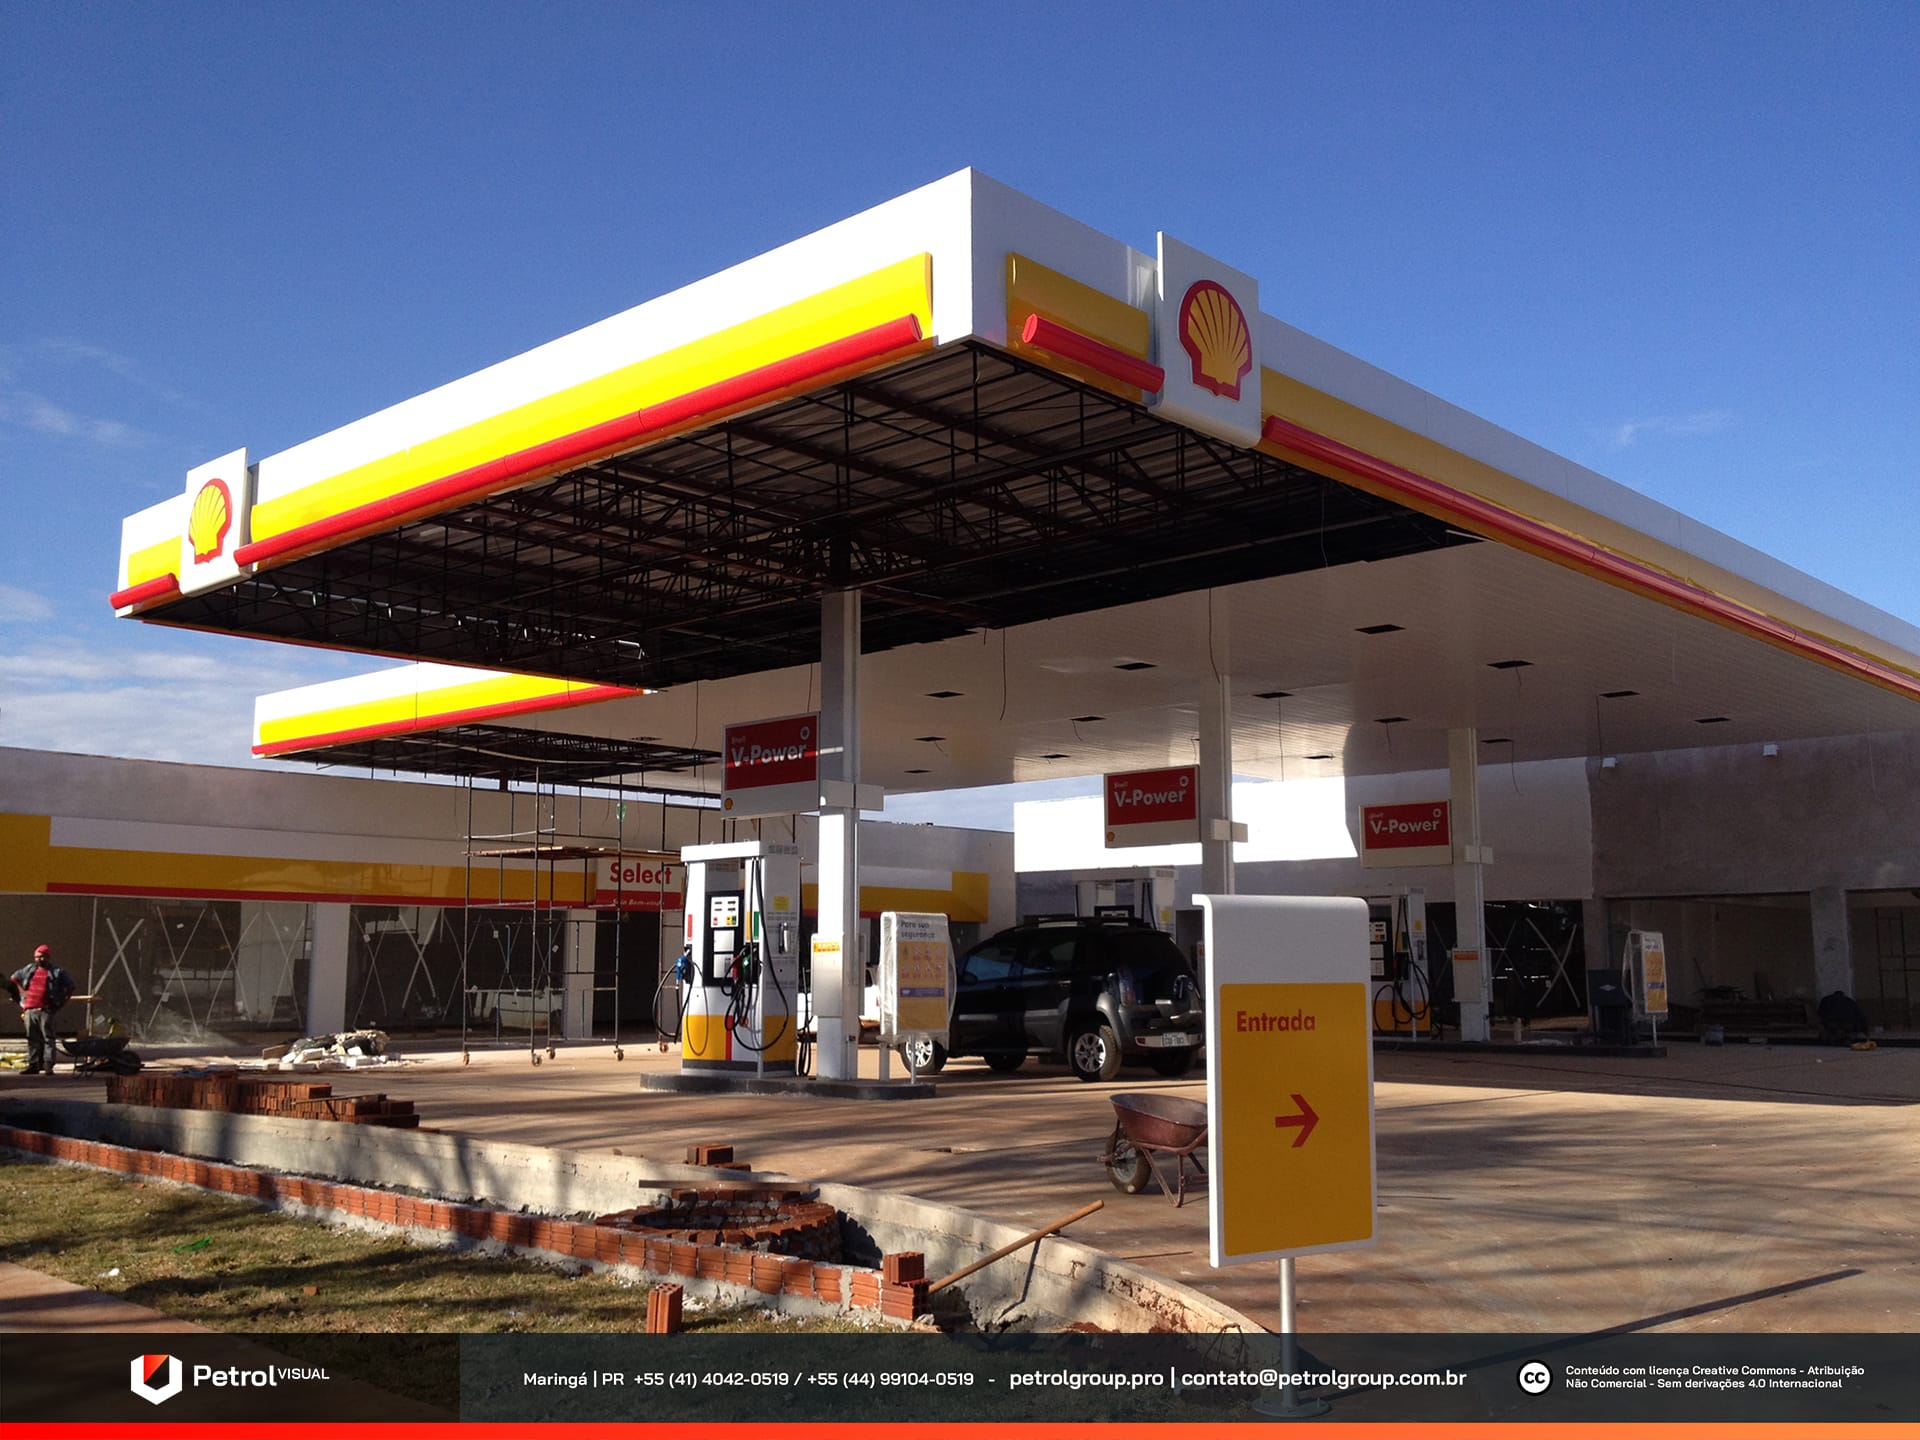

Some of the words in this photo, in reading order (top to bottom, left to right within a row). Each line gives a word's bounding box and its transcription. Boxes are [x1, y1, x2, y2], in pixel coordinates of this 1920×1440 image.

[731, 744, 807, 768] V-Power
[1114, 788, 1187, 808] V-Power
[1370, 819, 1440, 834] V-Power
[610, 862, 672, 885] Select
[1236, 1009, 1316, 1032] Entrada
